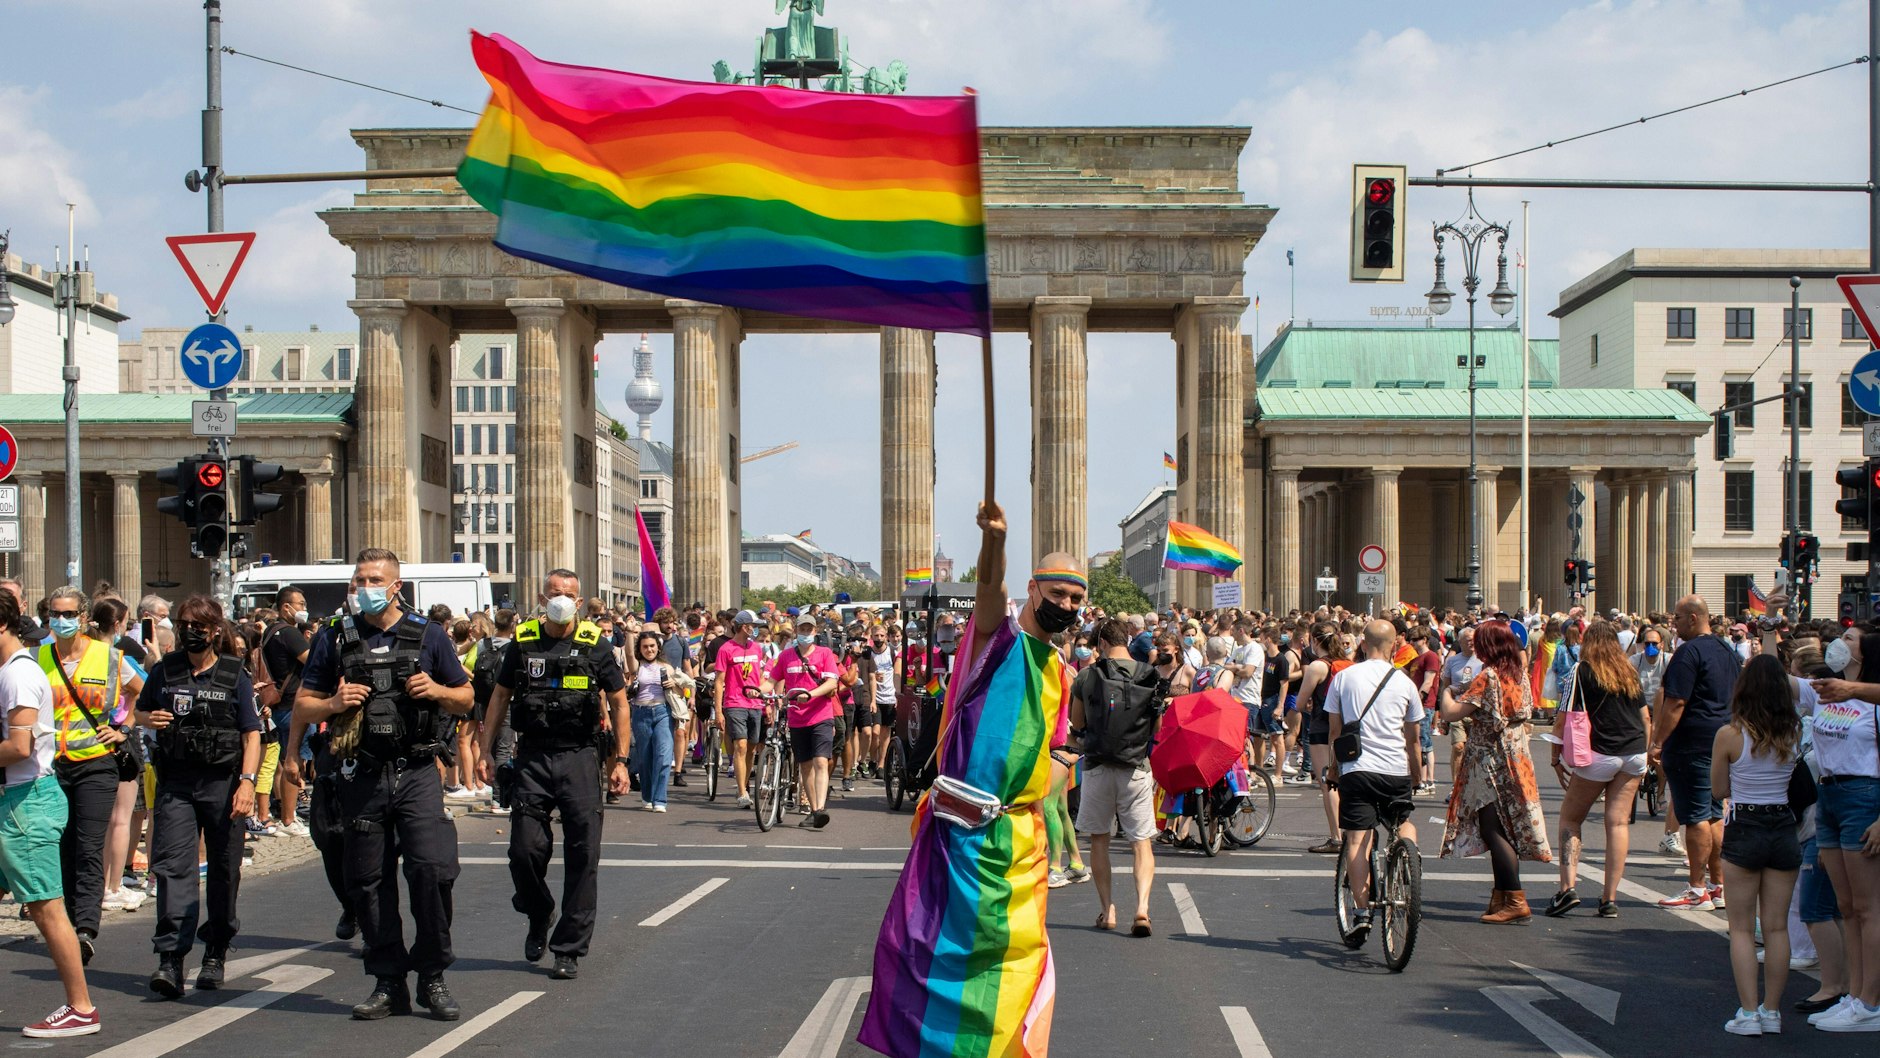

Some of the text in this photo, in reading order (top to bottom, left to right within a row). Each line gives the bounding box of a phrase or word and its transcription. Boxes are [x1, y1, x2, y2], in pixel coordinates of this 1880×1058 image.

[1369, 306, 1437, 316] HOTEL ADLO
[207, 424, 222, 432] frei
[565, 678, 587, 687] POLIZEI
[197, 690, 226, 701] POLIZEI
[369, 724, 393, 734] POLIZEI
